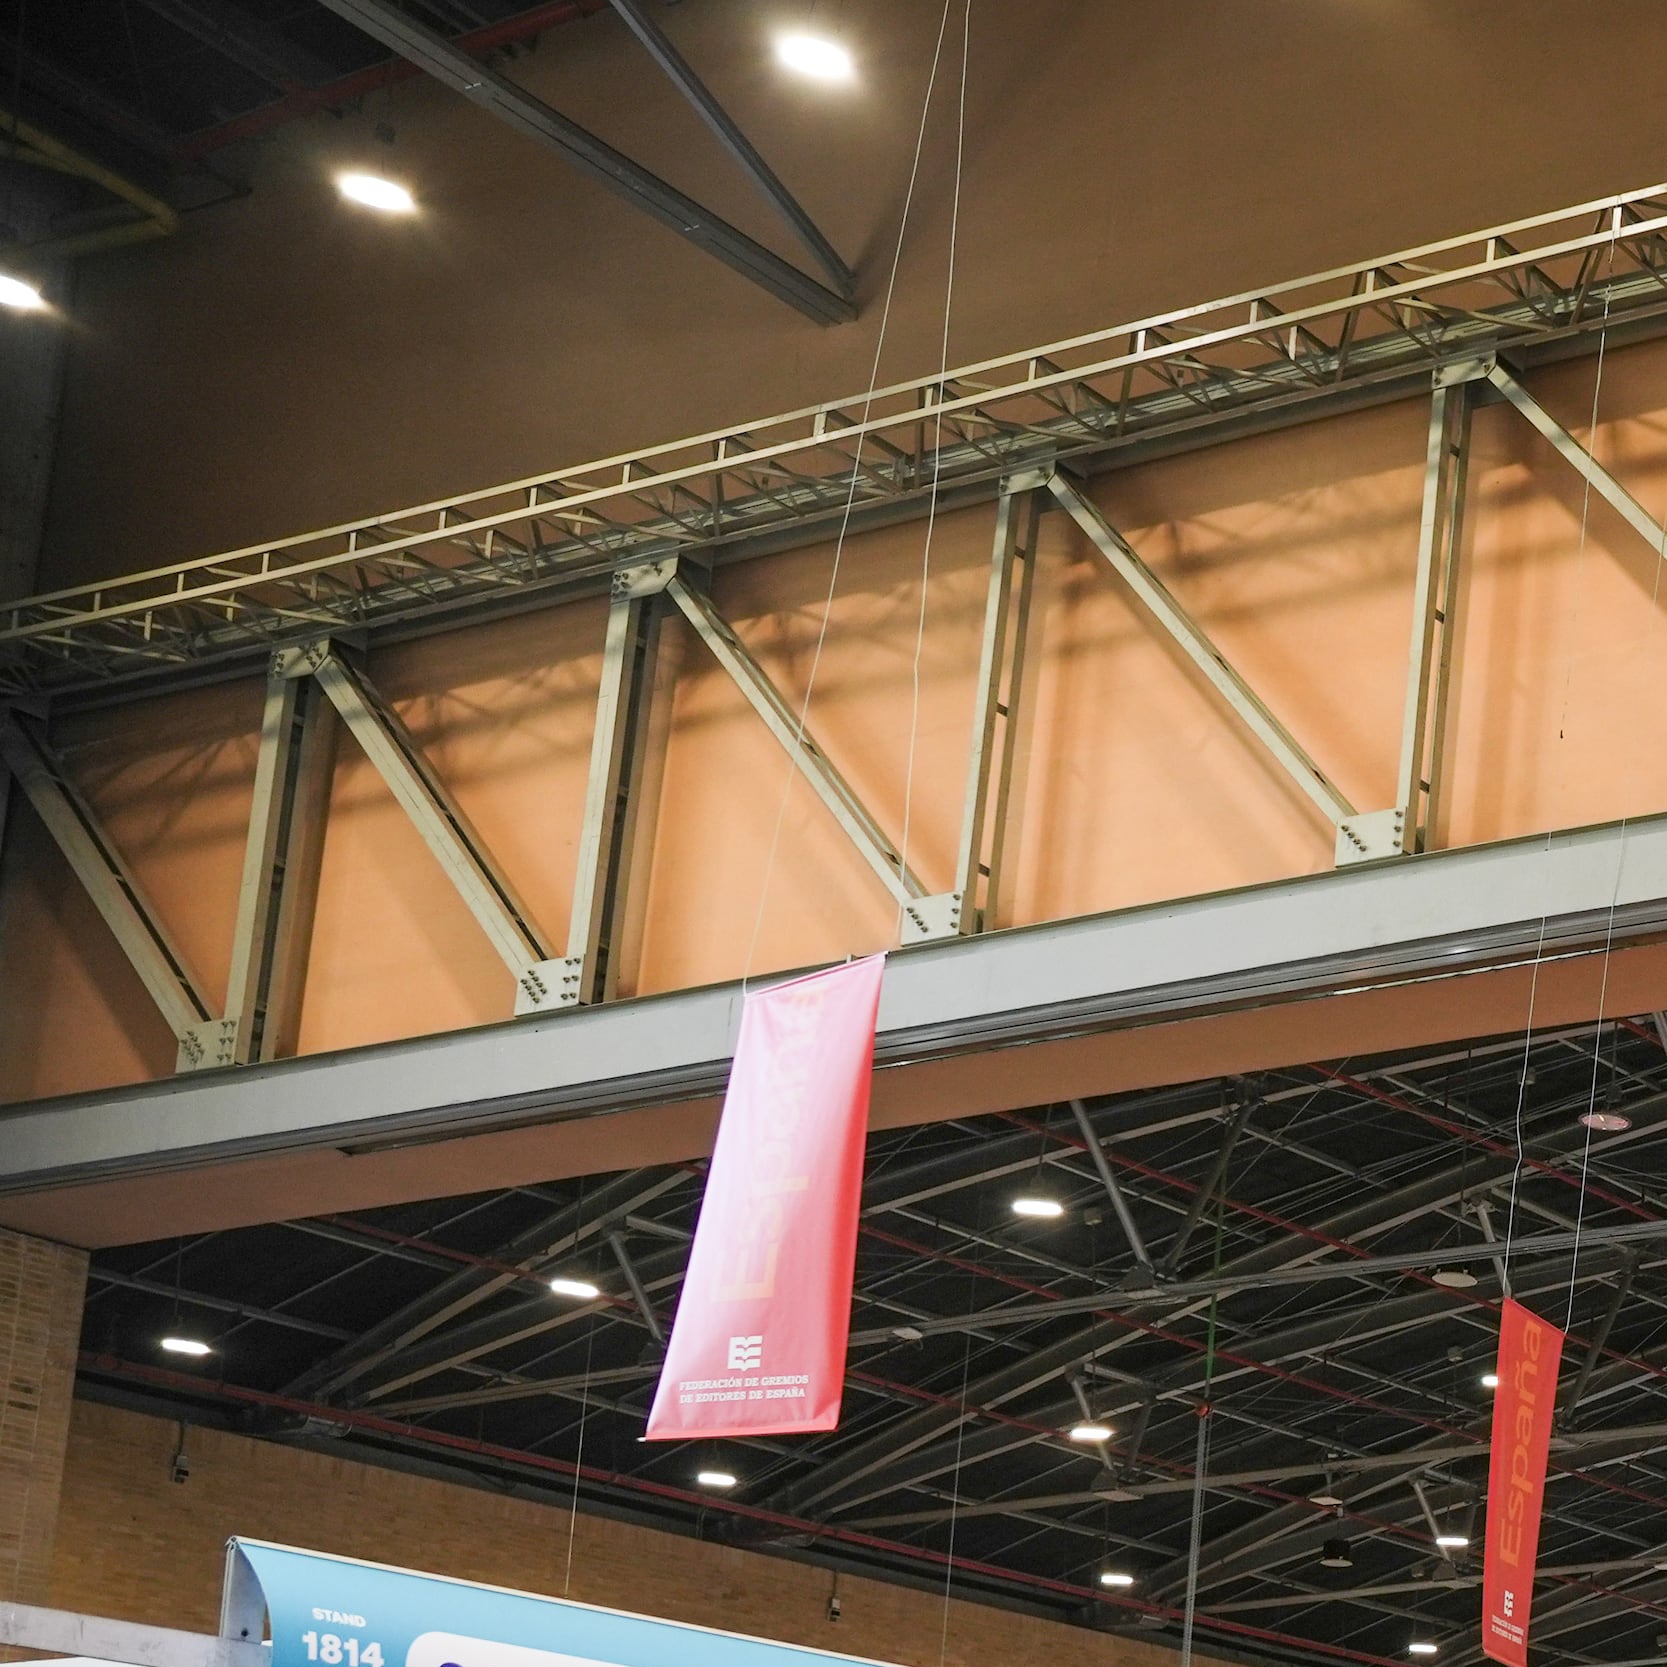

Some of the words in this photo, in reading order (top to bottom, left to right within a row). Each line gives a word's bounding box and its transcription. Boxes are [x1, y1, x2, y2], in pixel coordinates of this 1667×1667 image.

[717, 985, 827, 1301] España
[679, 1376, 742, 1391] FEDERACIÓN
[745, 1377, 759, 1388] DE
[761, 1375, 809, 1387] GREMIOS
[680, 1393, 694, 1404] DE
[695, 1390, 746, 1404] EDITORES
[749, 1389, 764, 1401] DE
[767, 1386, 806, 1399] ESPAÑA
[1501, 1319, 1543, 1569] España
[312, 1607, 367, 1628] STAND
